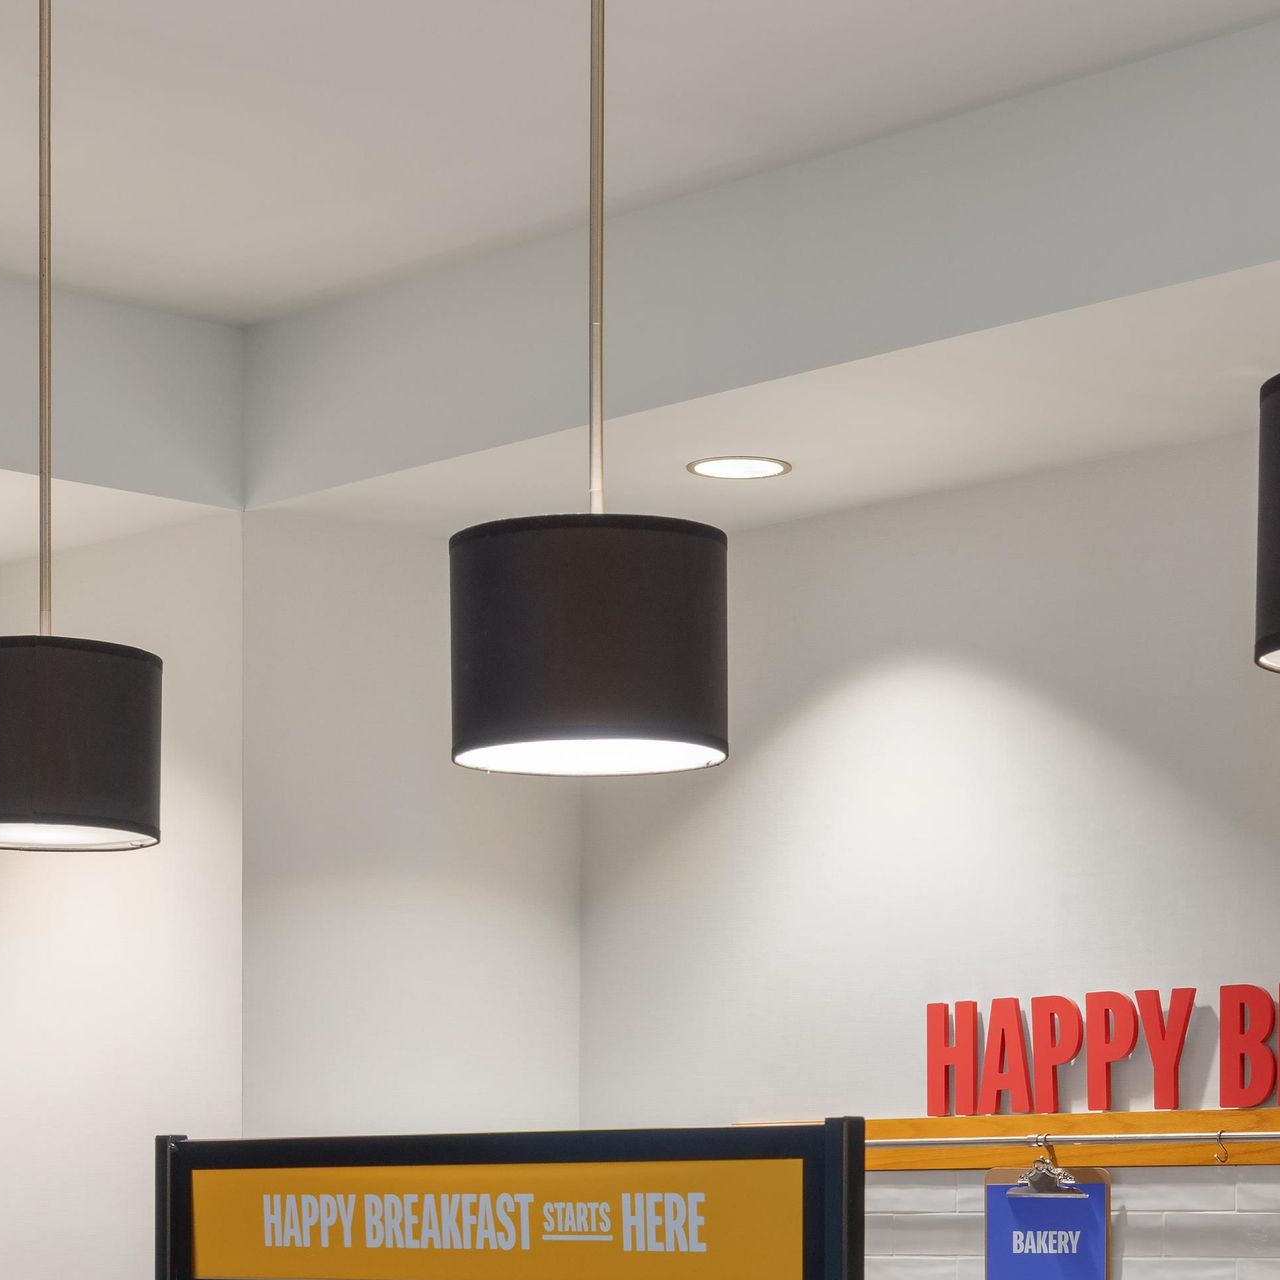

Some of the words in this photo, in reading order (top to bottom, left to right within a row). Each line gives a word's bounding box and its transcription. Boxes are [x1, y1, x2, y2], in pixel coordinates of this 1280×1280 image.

[926, 987, 1197, 1117] HAPPY
[263, 1194, 357, 1248] HAPPY
[363, 1193, 535, 1251] BREAKFAST
[542, 1201, 612, 1233] STARTS
[621, 1192, 708, 1252] HERE
[1012, 1230, 1081, 1254] BAKERY
